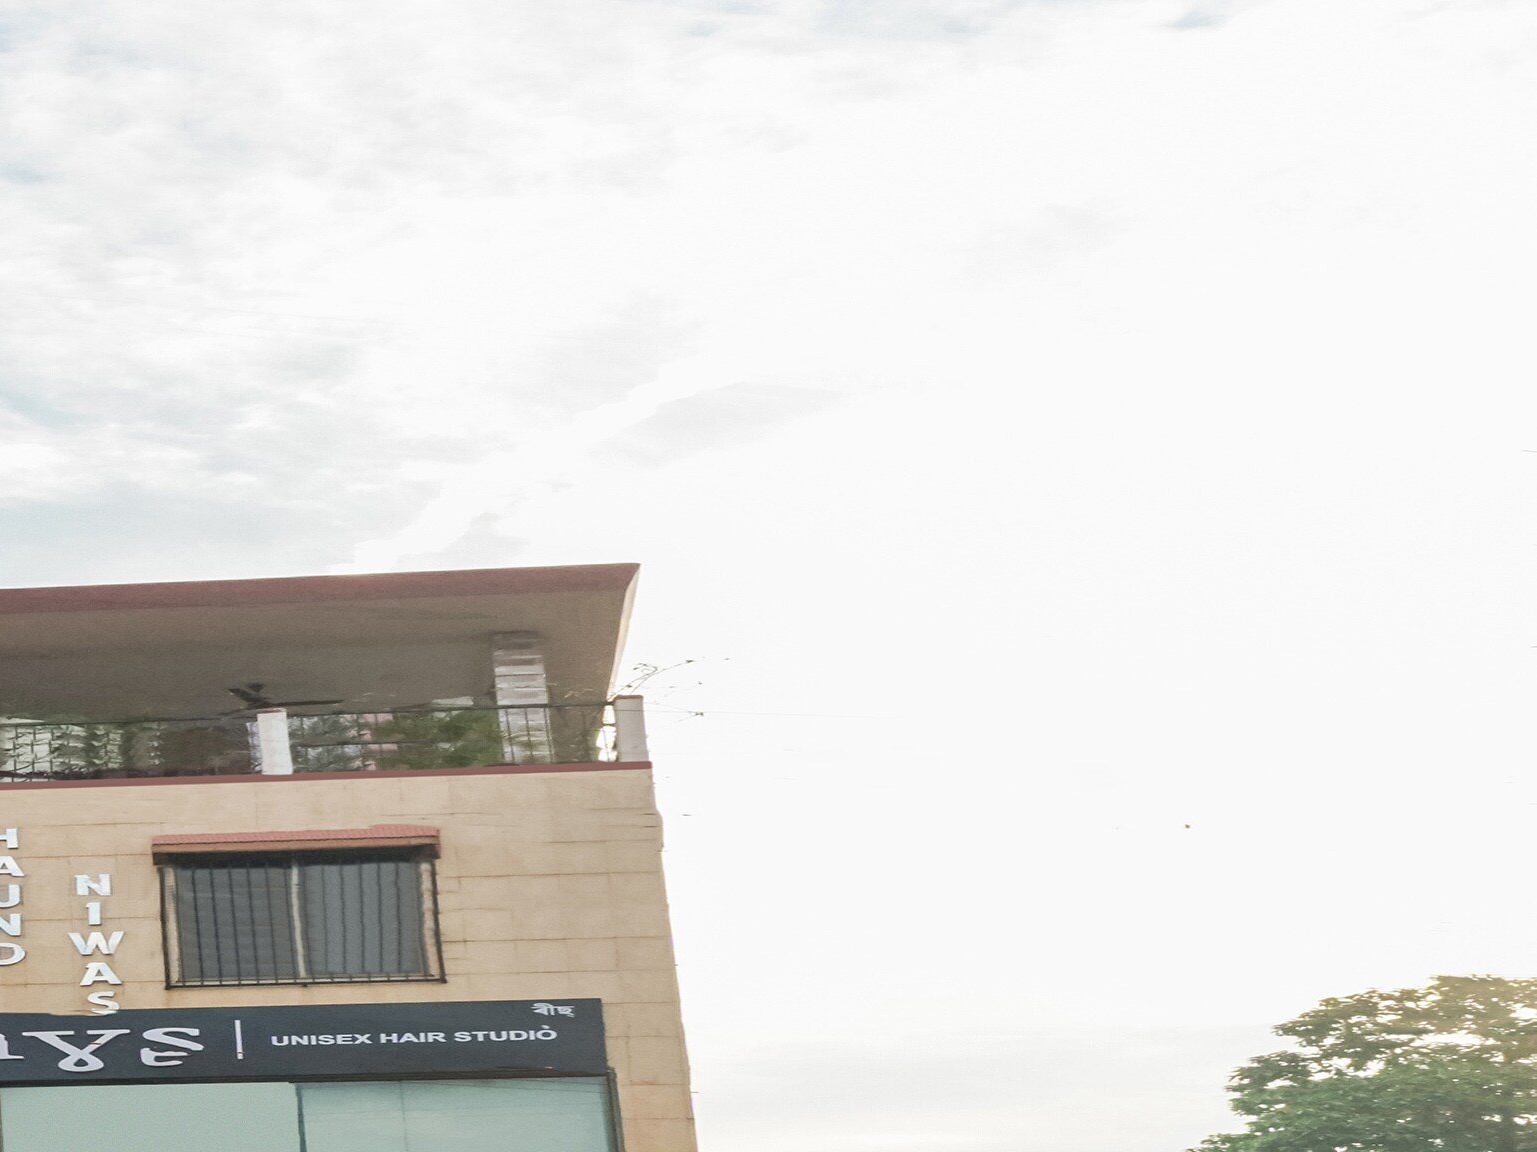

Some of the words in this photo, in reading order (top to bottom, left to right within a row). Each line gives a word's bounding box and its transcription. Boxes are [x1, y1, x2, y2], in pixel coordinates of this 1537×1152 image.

[68, 873, 125, 1016] NIWAS
[271, 1033, 372, 1046] UNISEX
[379, 1031, 447, 1044] HAIR
[453, 1029, 558, 1042] STUDIO
